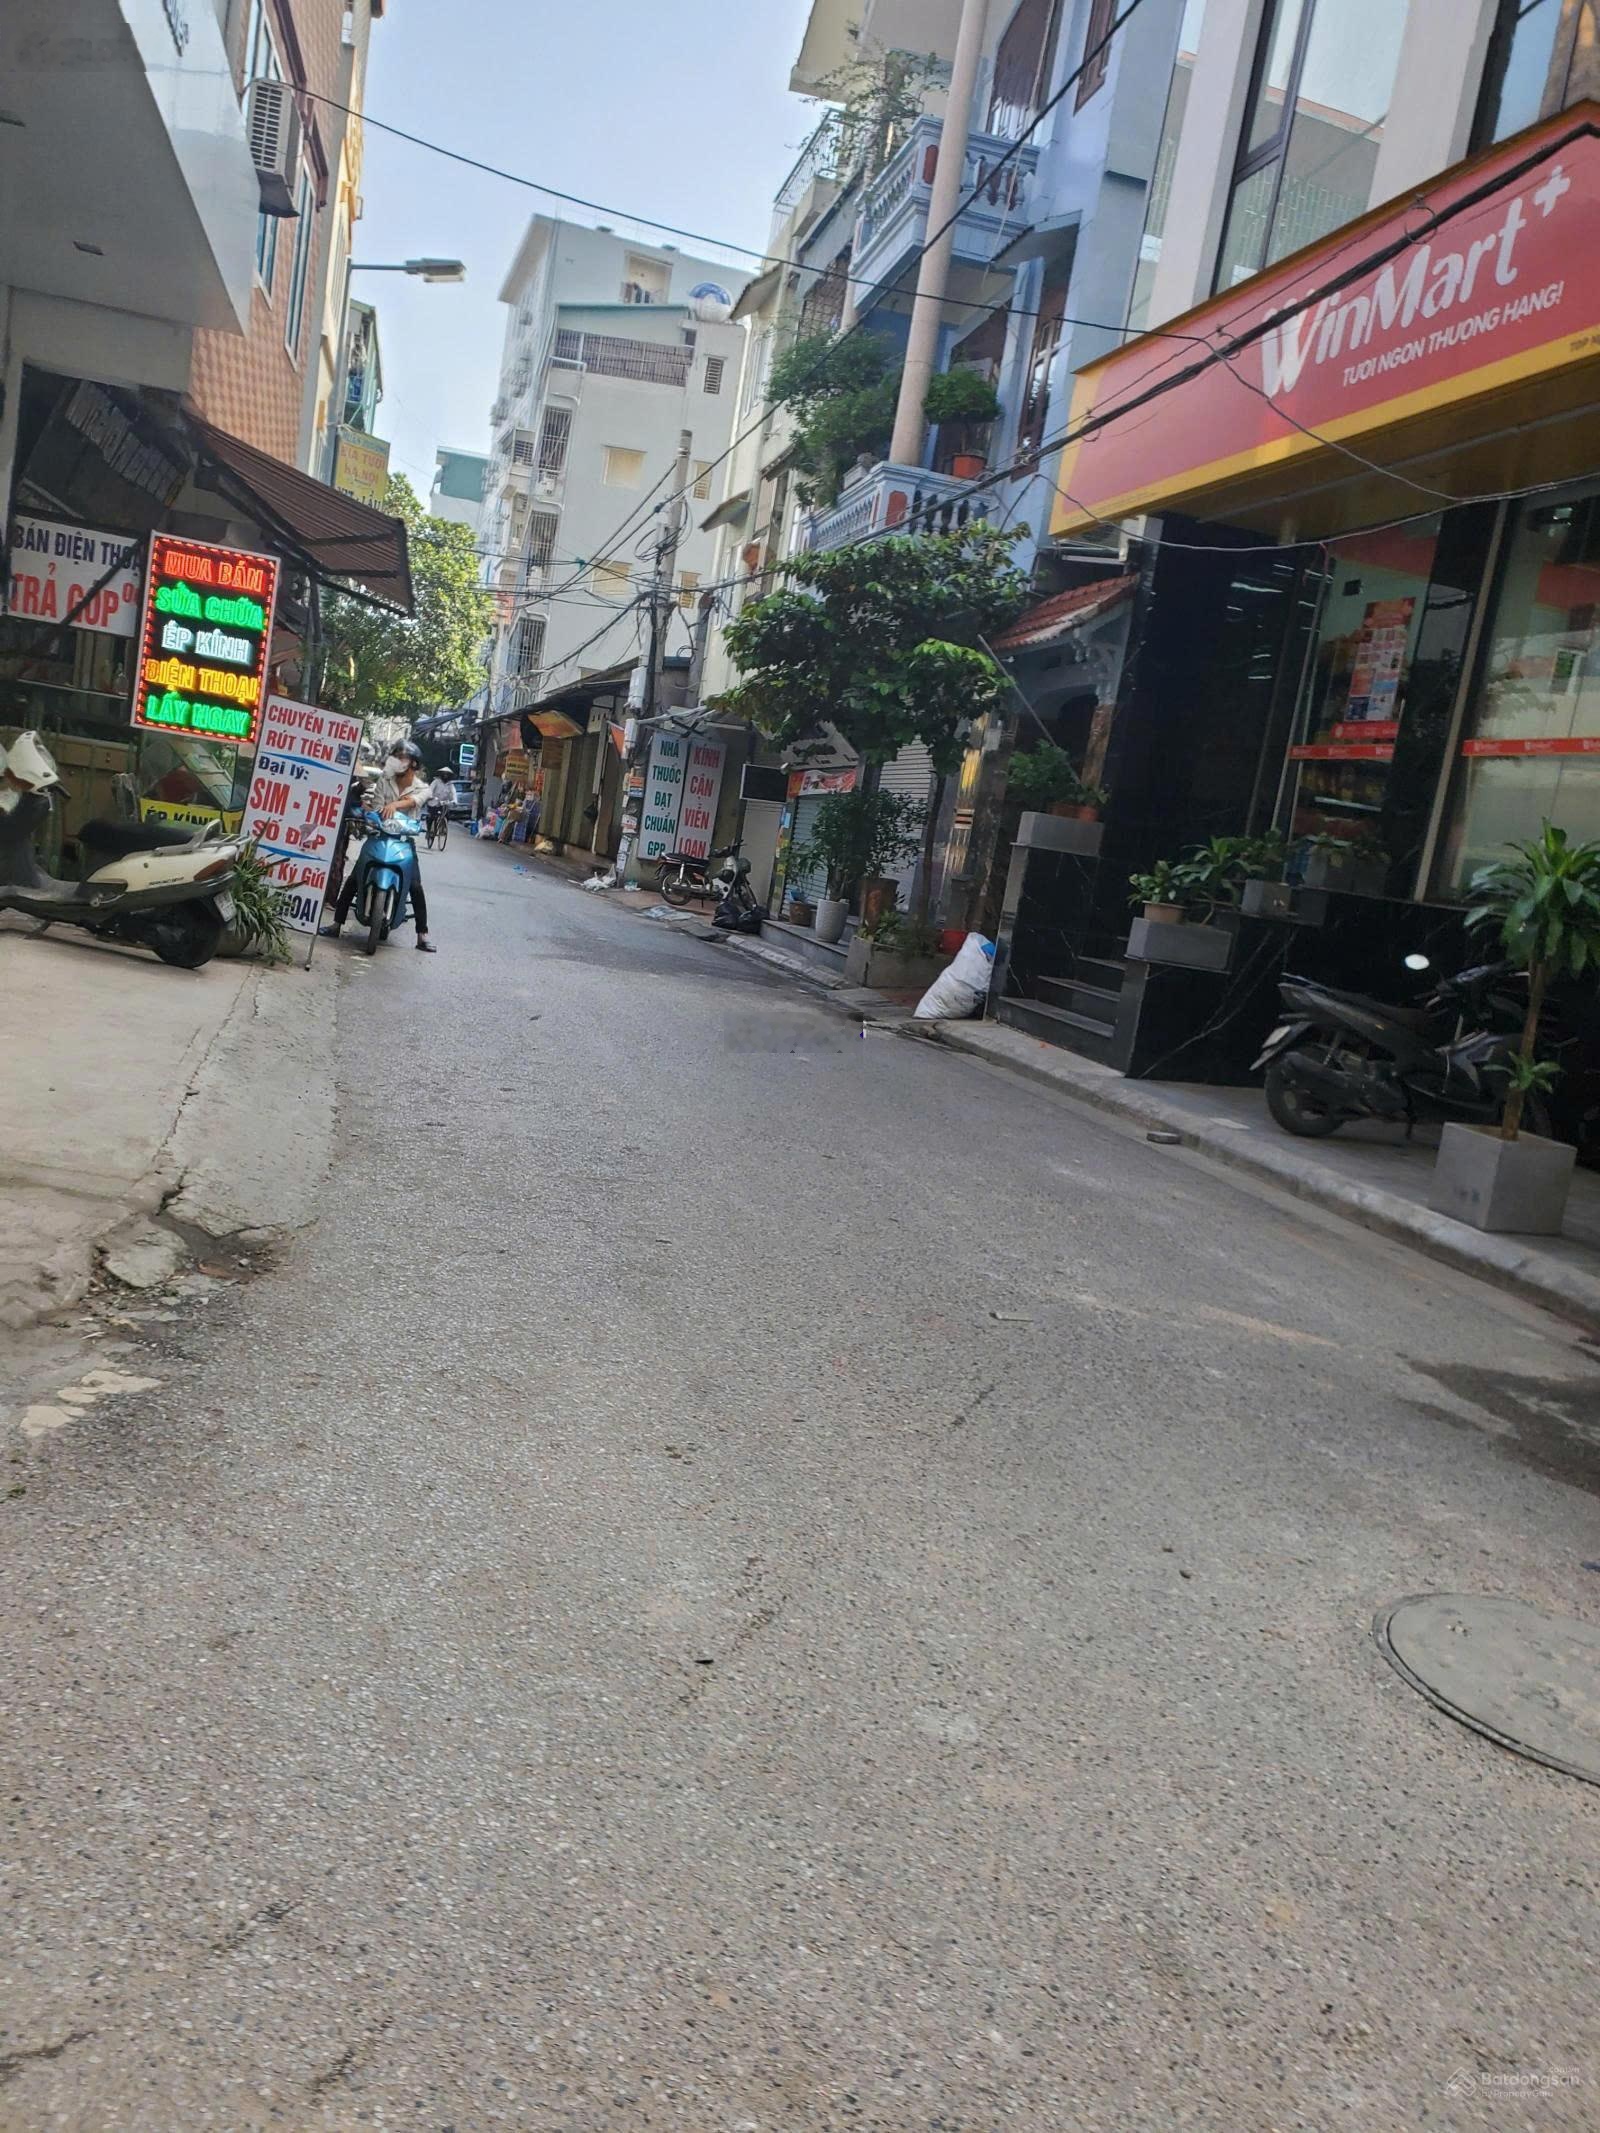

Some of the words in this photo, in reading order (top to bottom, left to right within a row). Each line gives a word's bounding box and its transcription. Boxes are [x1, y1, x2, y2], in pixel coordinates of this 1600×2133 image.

[1377, 337, 1426, 374] NGON
[13, 521, 50, 554] BÁN
[54, 531, 95, 565] ĐIỆN
[101, 541, 141, 577] THOẠ
[164, 550, 213, 583] MUA
[218, 559, 264, 592] BÁN
[9, 562, 57, 619] TRẢ
[195, 628, 250, 662] KÍNH
[145, 657, 196, 691] ĐIỆN
[199, 668, 259, 704] THOẠI
[146, 691, 190, 726] LẤY
[192, 703, 249, 736] NGAY
[268, 704, 325, 735] CHUYỂN
[266, 729, 296, 751] RÚT
[258, 756, 286, 776] Đại
[290, 763, 310, 781] lý:
[693, 743, 721, 769] KÍNH
[652, 762, 682, 785] THUỐC
[689, 772, 714, 800] CẬN
[250, 778, 291, 816] SIM
[305, 783, 342, 829] THẺ
[654, 790, 673, 811] ĐẠT
[252, 818, 281, 842] SỐ
[644, 811, 676, 835] CHUẨN
[647, 840, 666, 858] GPP
